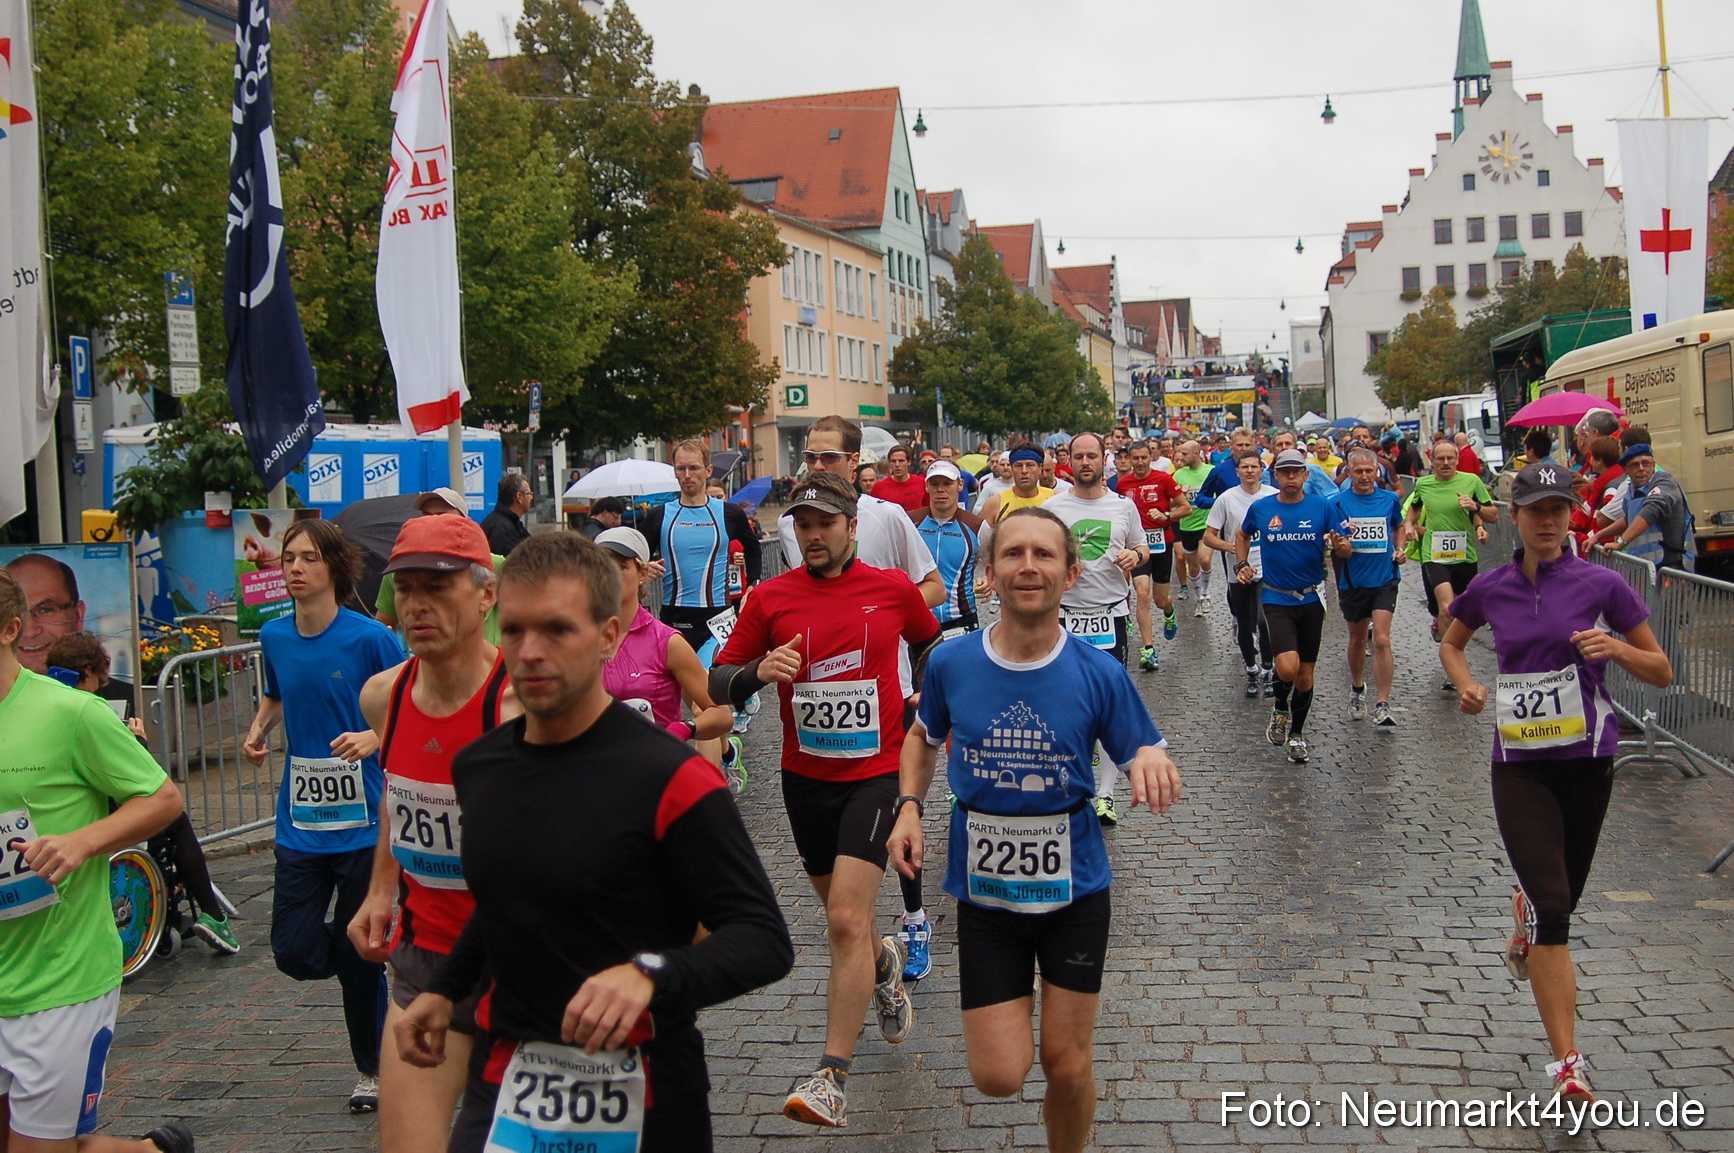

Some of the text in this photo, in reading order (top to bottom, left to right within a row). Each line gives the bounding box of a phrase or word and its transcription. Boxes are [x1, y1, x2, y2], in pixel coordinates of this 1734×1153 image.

[75, 345, 86, 391] P
[1625, 365, 1675, 394] Bayerisches
[788, 387, 805, 404] D
[1194, 395, 1224, 403] START
[1625, 397, 1649, 415] Rotes
[309, 459, 341, 483] DIXI
[364, 458, 398, 483] DIXI
[1538, 468, 1556, 484] NY
[1276, 533, 1316, 541] BARCLAYS
[1353, 526, 1384, 540] 2553
[1442, 539, 1456, 551] 50
[1071, 616, 1110, 633] 2750
[824, 658, 848, 672] DEHN
[795, 689, 862, 698] PARTL Neumarkt
[1498, 682, 1524, 690] PARTL
[1512, 687, 1562, 720] 321
[801, 700, 871, 729] 2329
[1521, 724, 1561, 738] Kathrin
[815, 737, 858, 747] Manuel
[962, 746, 1077, 766] 13. Neumarkter Stadtlauf
[292, 763, 347, 773] PARTL Neumarkt
[295, 775, 357, 802] 2990
[388, 784, 415, 801] PARTL
[312, 809, 340, 820] Timo
[397, 804, 463, 850] 261
[969, 821, 1052, 836] PARTL Neumarkt
[977, 838, 1061, 876] 2256
[977, 880, 1061, 902] Hans-Jürgen
[550, 1055, 615, 1075] Neumarkt
[513, 1071, 629, 1124] 2565
